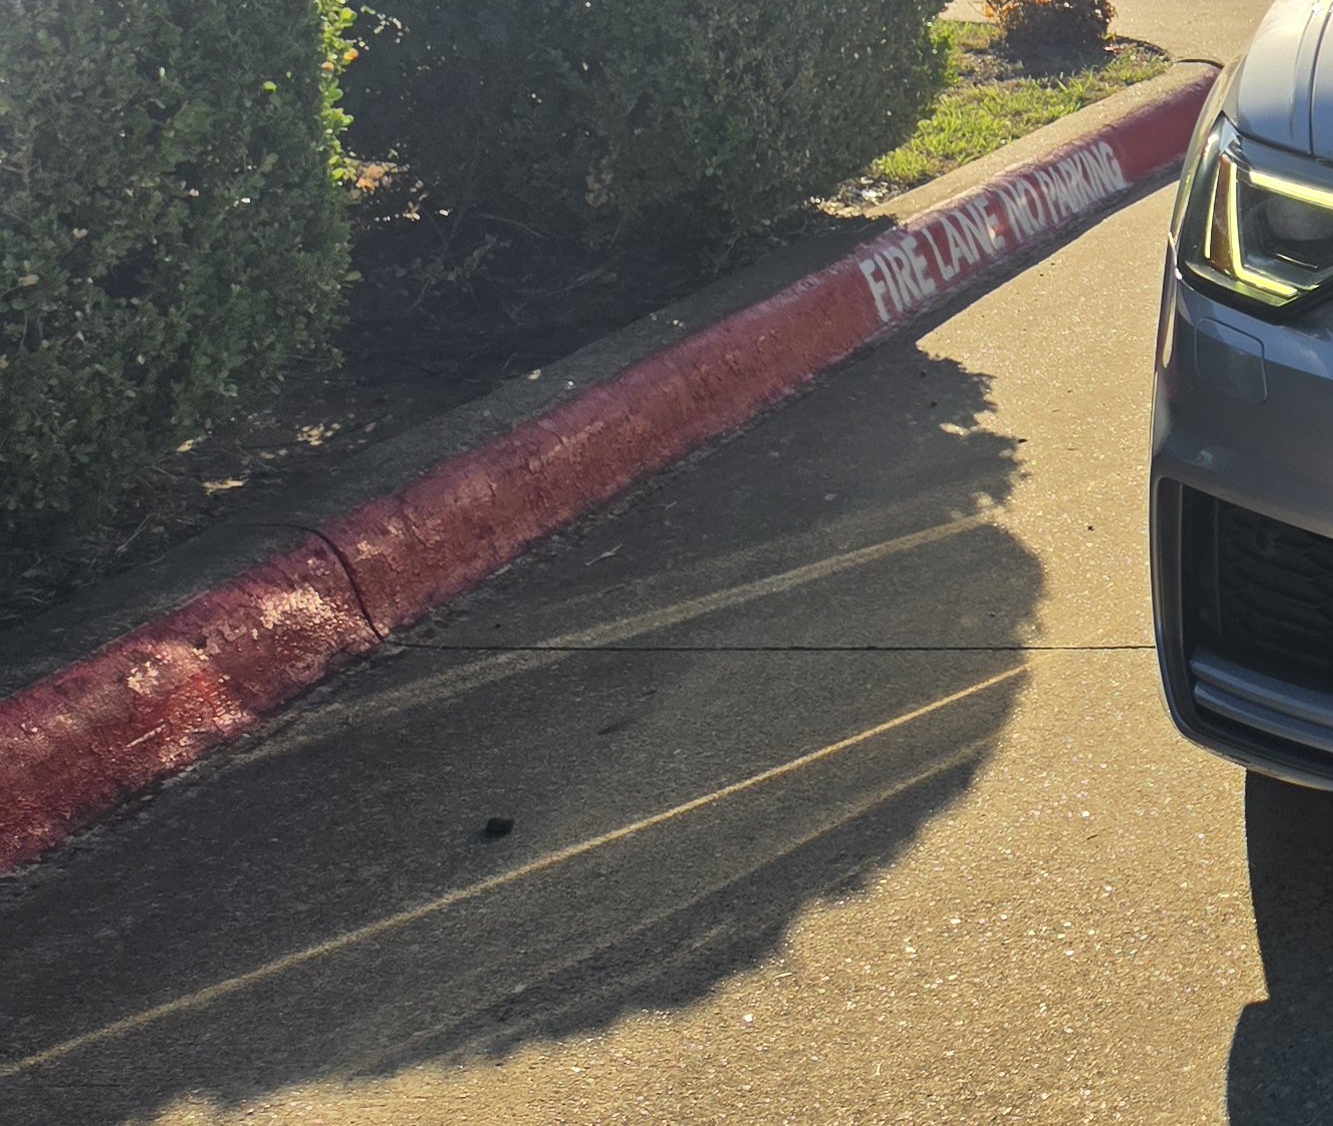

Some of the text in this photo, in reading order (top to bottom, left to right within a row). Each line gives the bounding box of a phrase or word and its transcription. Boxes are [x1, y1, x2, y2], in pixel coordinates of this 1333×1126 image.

[859, 140, 1129, 322] FIRE LANE NO PARKING
